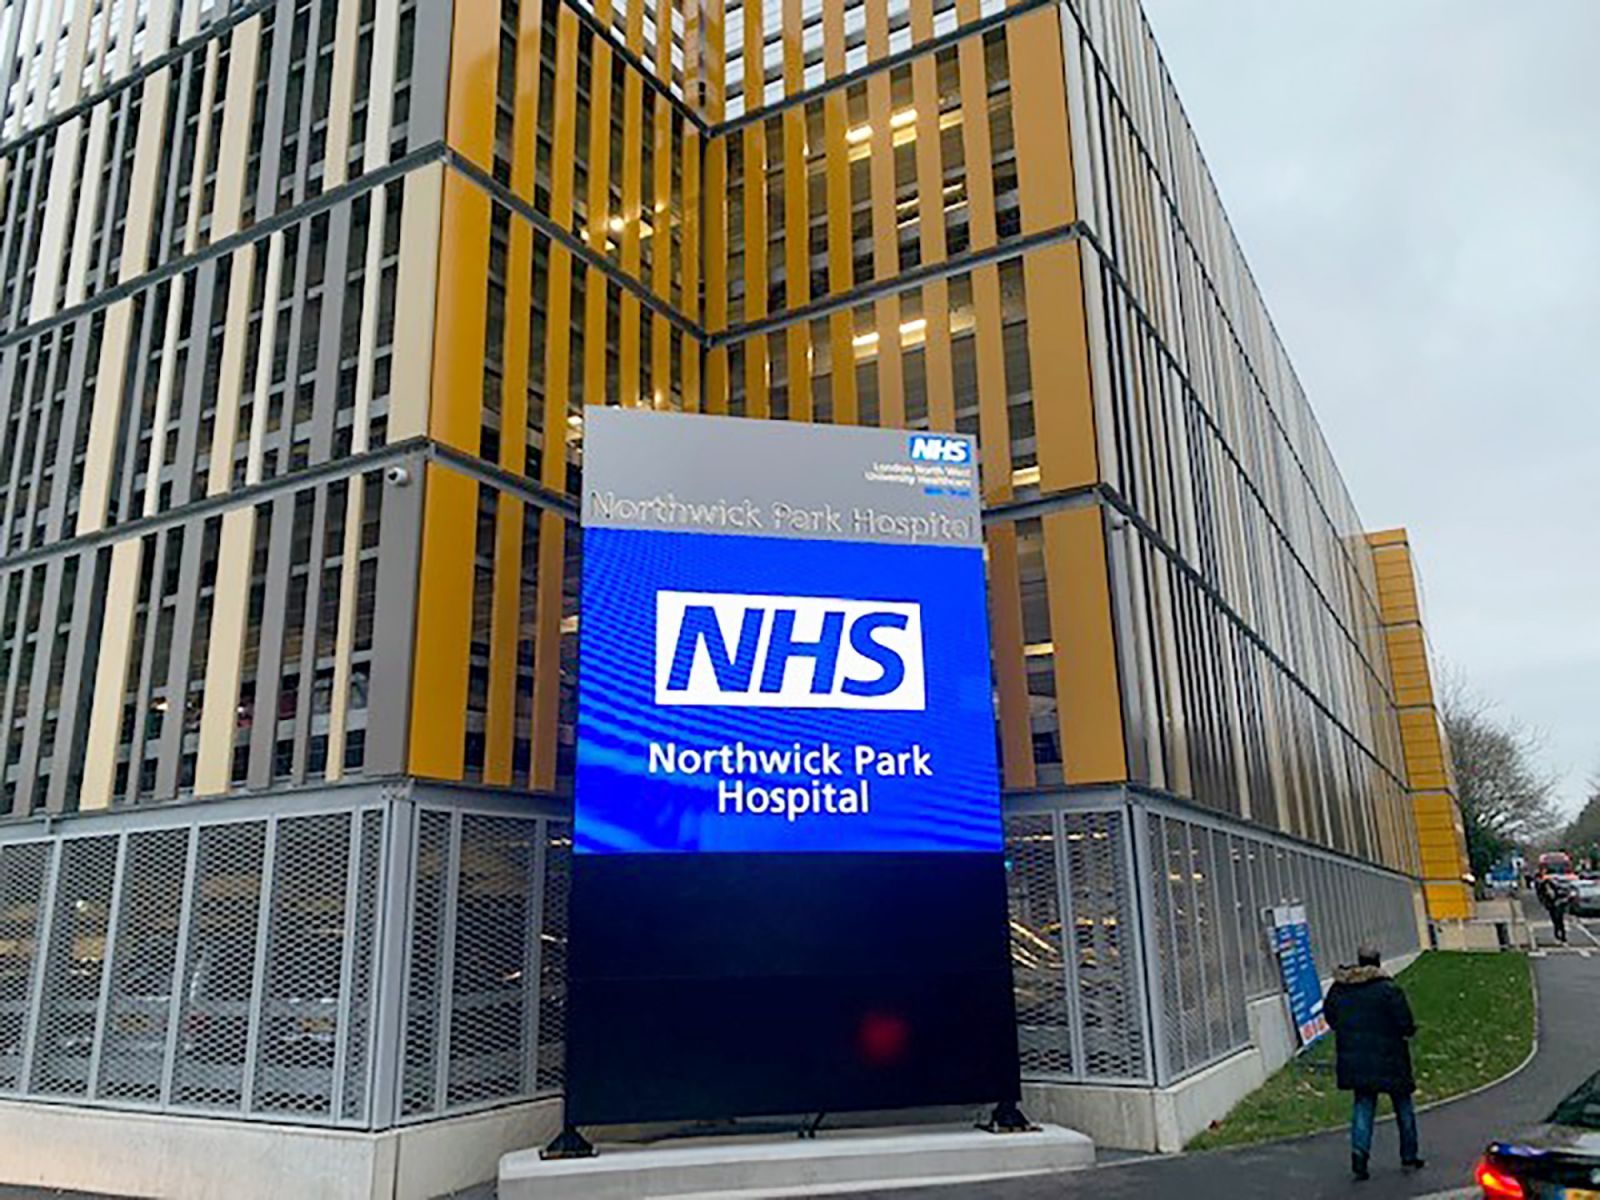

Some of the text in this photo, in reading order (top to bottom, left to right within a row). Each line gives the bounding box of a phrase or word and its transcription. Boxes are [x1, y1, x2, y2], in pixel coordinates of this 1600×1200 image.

[912, 438, 967, 462] NHS
[591, 490, 973, 544] Northwick Park Hospital
[666, 605, 908, 697] NHS
[648, 742, 933, 777] Northwick Park
[718, 779, 869, 822] Hospital
